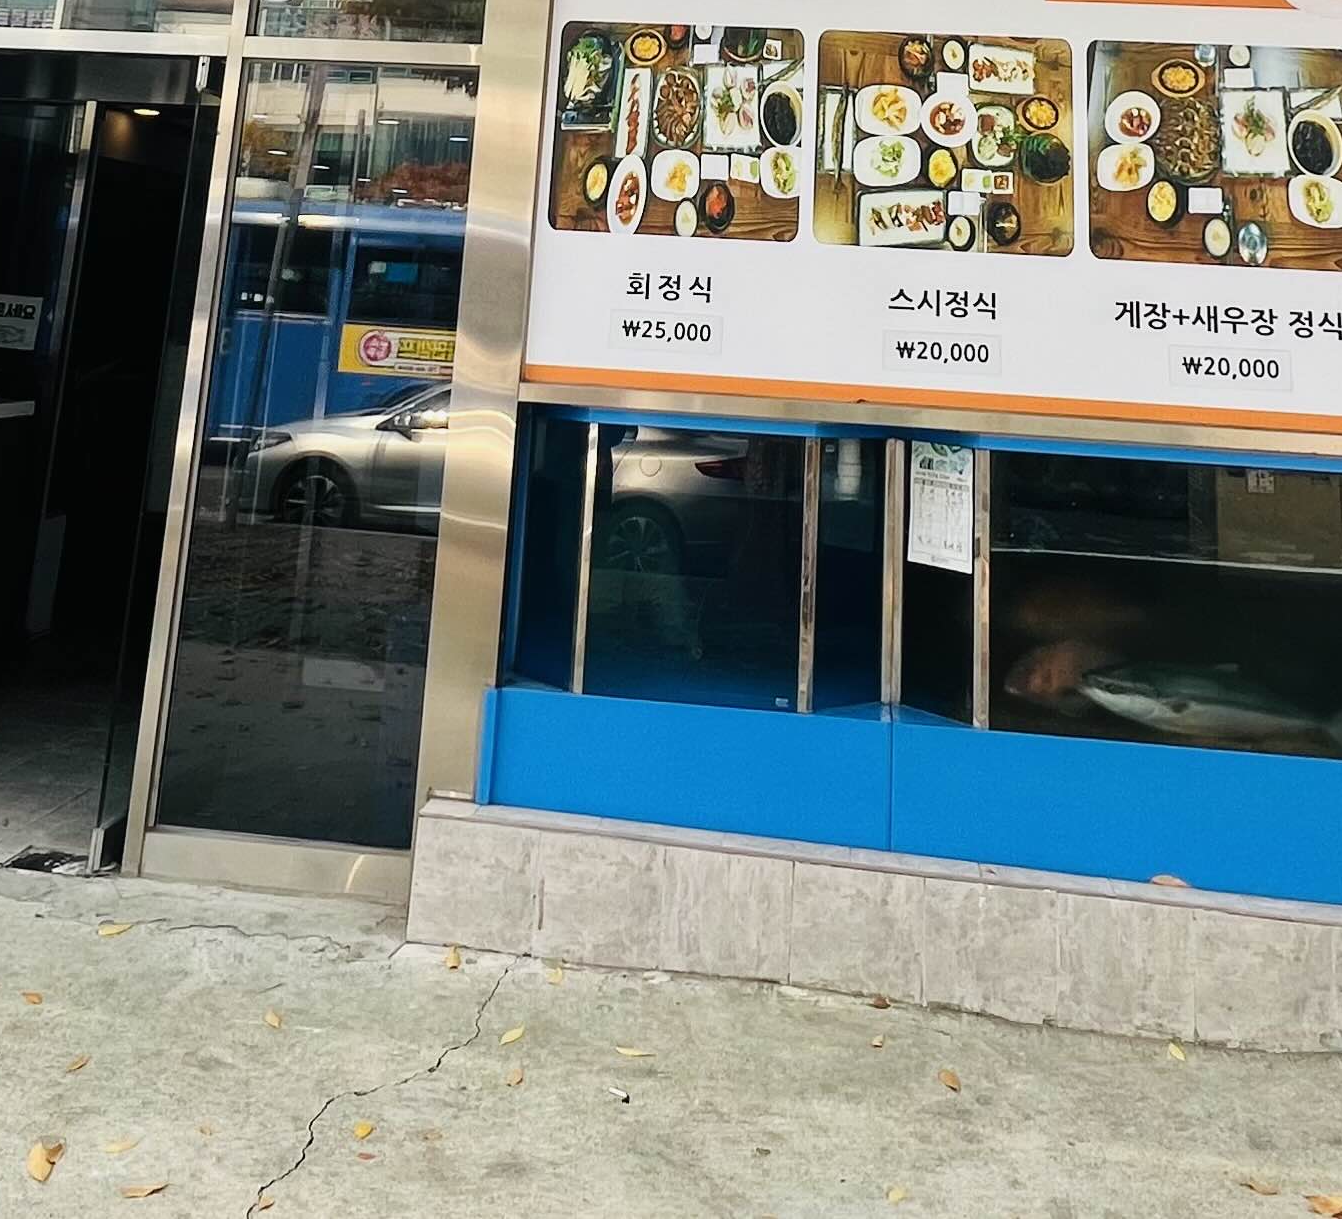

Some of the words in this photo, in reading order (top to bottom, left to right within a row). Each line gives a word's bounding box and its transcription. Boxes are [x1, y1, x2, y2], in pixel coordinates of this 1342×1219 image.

[625, 272, 714, 304] 회정식
[887, 287, 998, 322] 스시정식
[1113, 298, 1280, 337] 게장+새우장
[621, 318, 713, 346] ₩25,000
[894, 338, 991, 366] ₩20,000
[1180, 354, 1281, 382] ₩20,000
